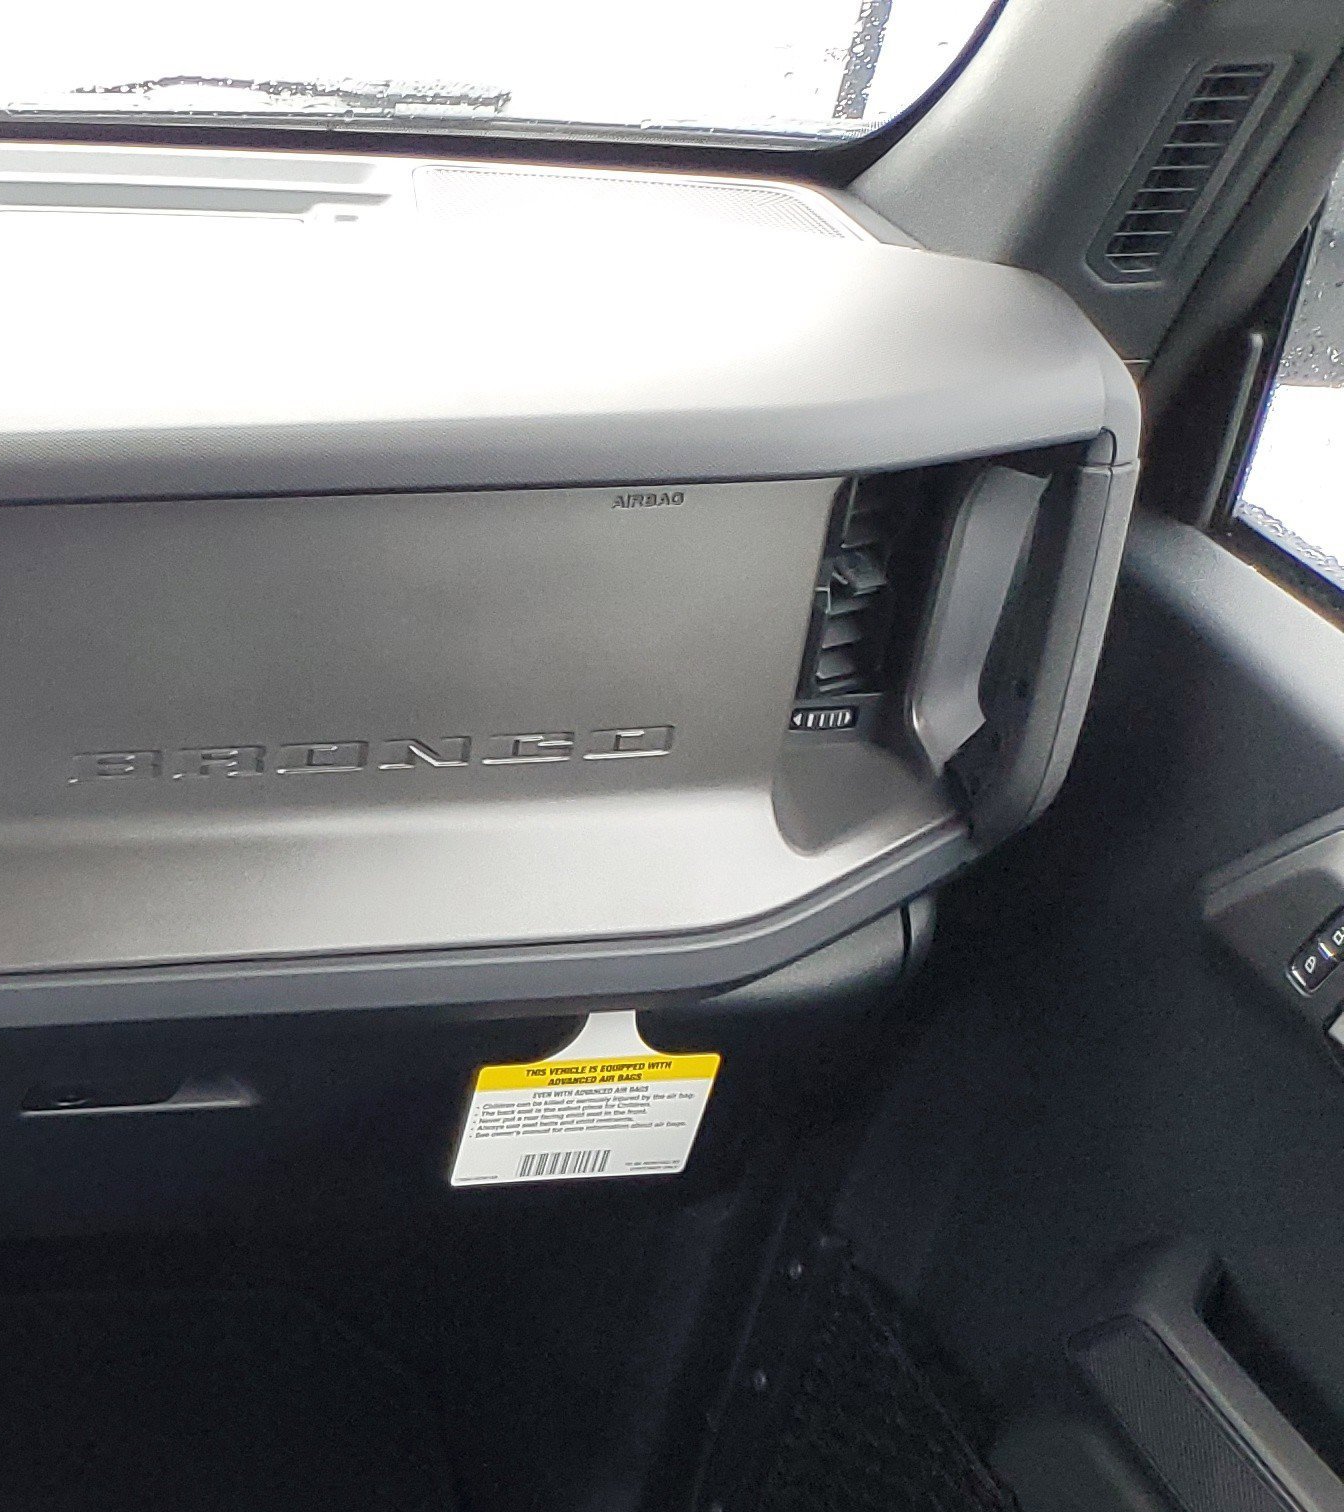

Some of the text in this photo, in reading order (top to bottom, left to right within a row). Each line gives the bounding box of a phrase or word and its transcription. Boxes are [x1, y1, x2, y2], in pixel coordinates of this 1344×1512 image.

[611, 491, 685, 509] AIRBAG
[67, 724, 676, 785] BRONCO
[526, 1061, 673, 1077] THIS VEHICLE IS EQUIPPED WITH
[548, 1073, 643, 1087] ADVANCED AIR BAGS
